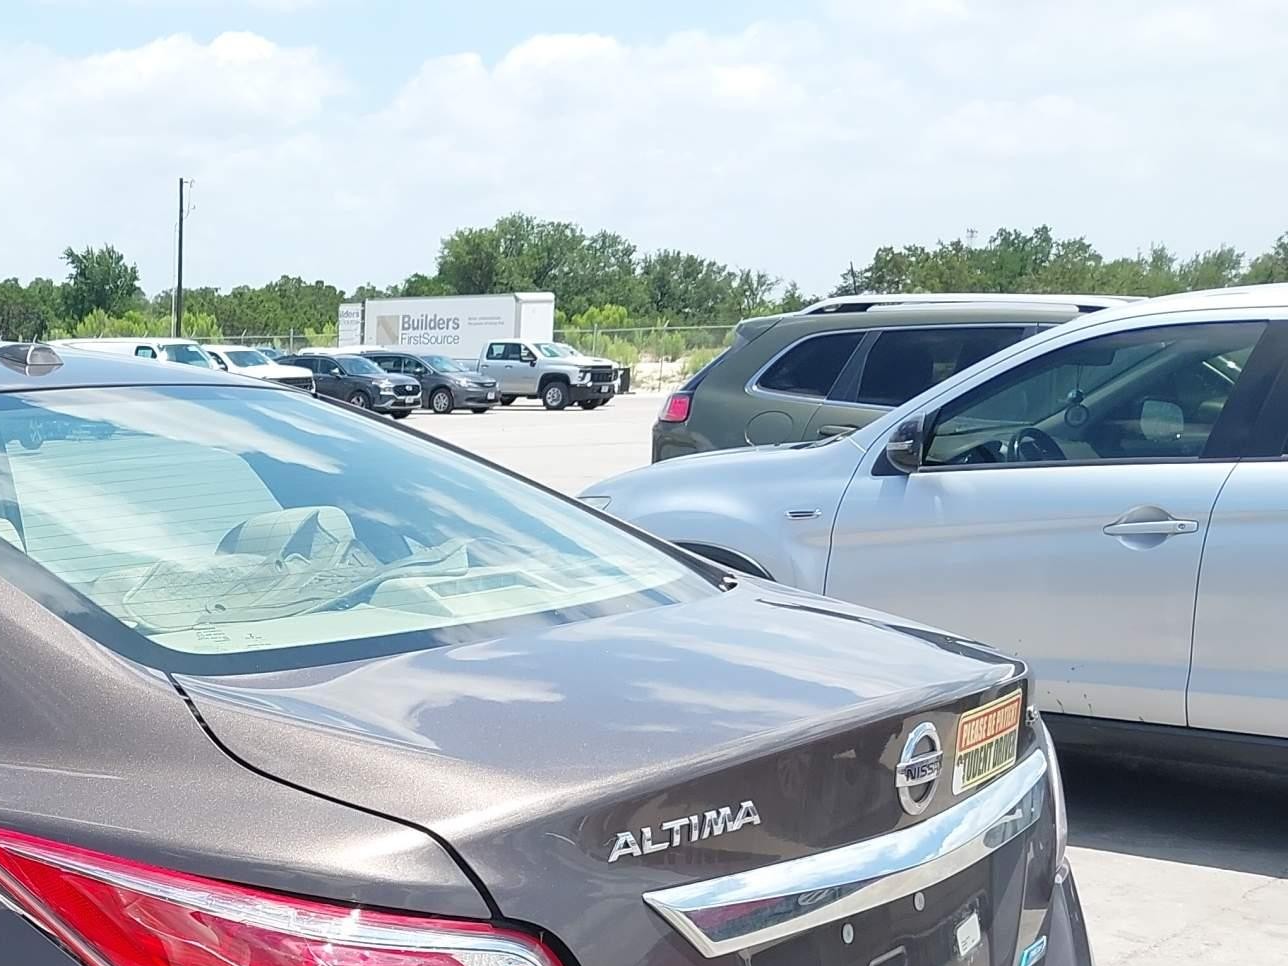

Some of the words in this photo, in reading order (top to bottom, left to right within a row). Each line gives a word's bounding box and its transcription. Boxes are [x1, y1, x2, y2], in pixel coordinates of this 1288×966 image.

[402, 314, 460, 331] Builders
[400, 332, 460, 346] FirstSource
[608, 800, 761, 863] ALTIMA
